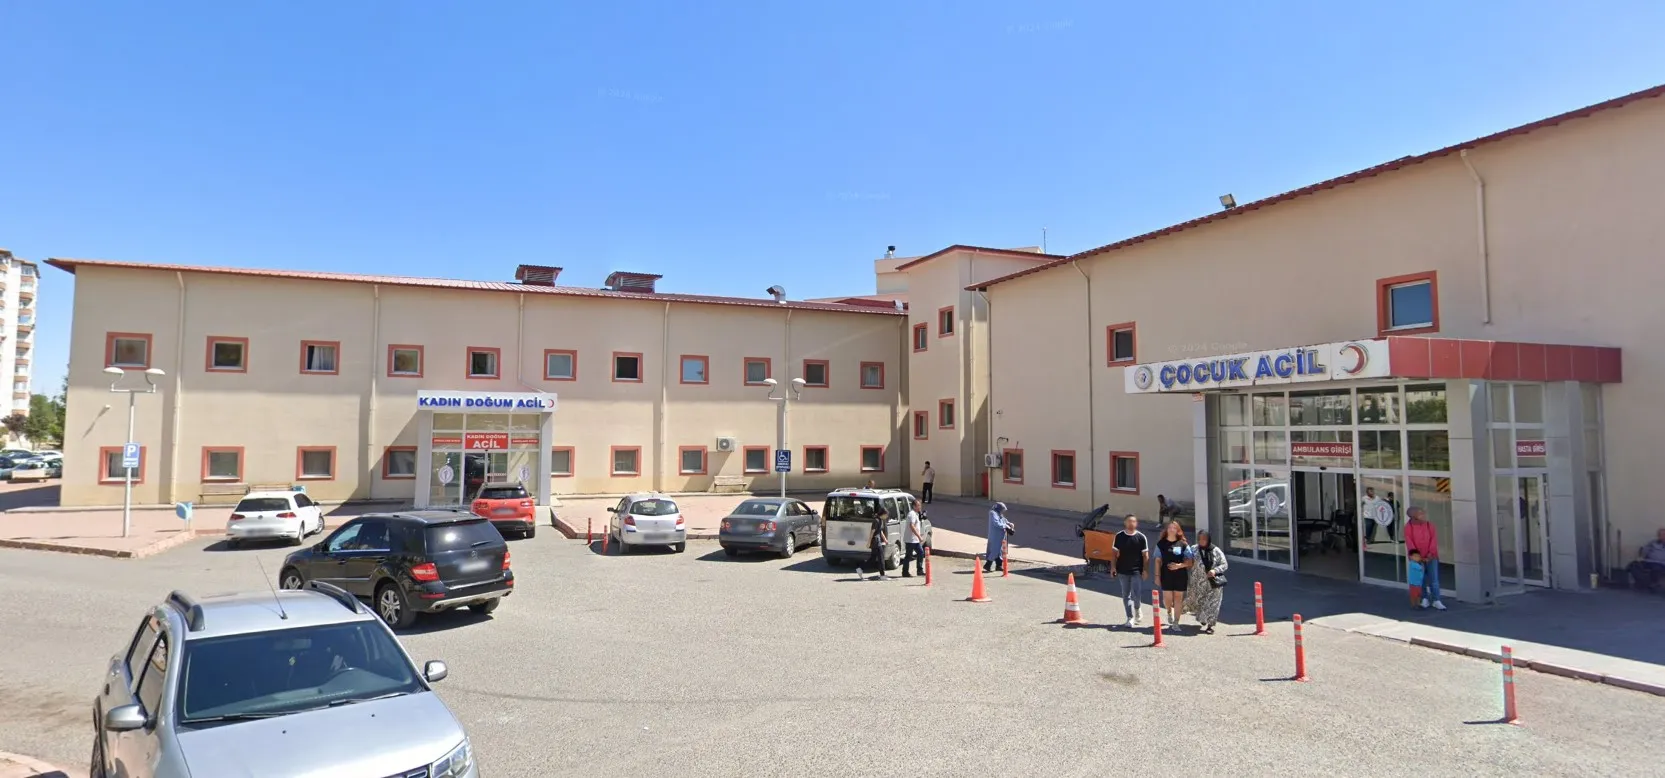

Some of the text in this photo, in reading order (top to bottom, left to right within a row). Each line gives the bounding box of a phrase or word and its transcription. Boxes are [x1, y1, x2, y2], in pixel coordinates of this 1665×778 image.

[1160, 357, 1249, 389] ÇOCUK
[1255, 348, 1326, 378] ACİL
[419, 397, 545, 408] KADIN DOĞUM ACİL
[473, 439, 500, 448] ACİL
[127, 445, 136, 457] P
[1330, 445, 1352, 455] GİRİŞİ
